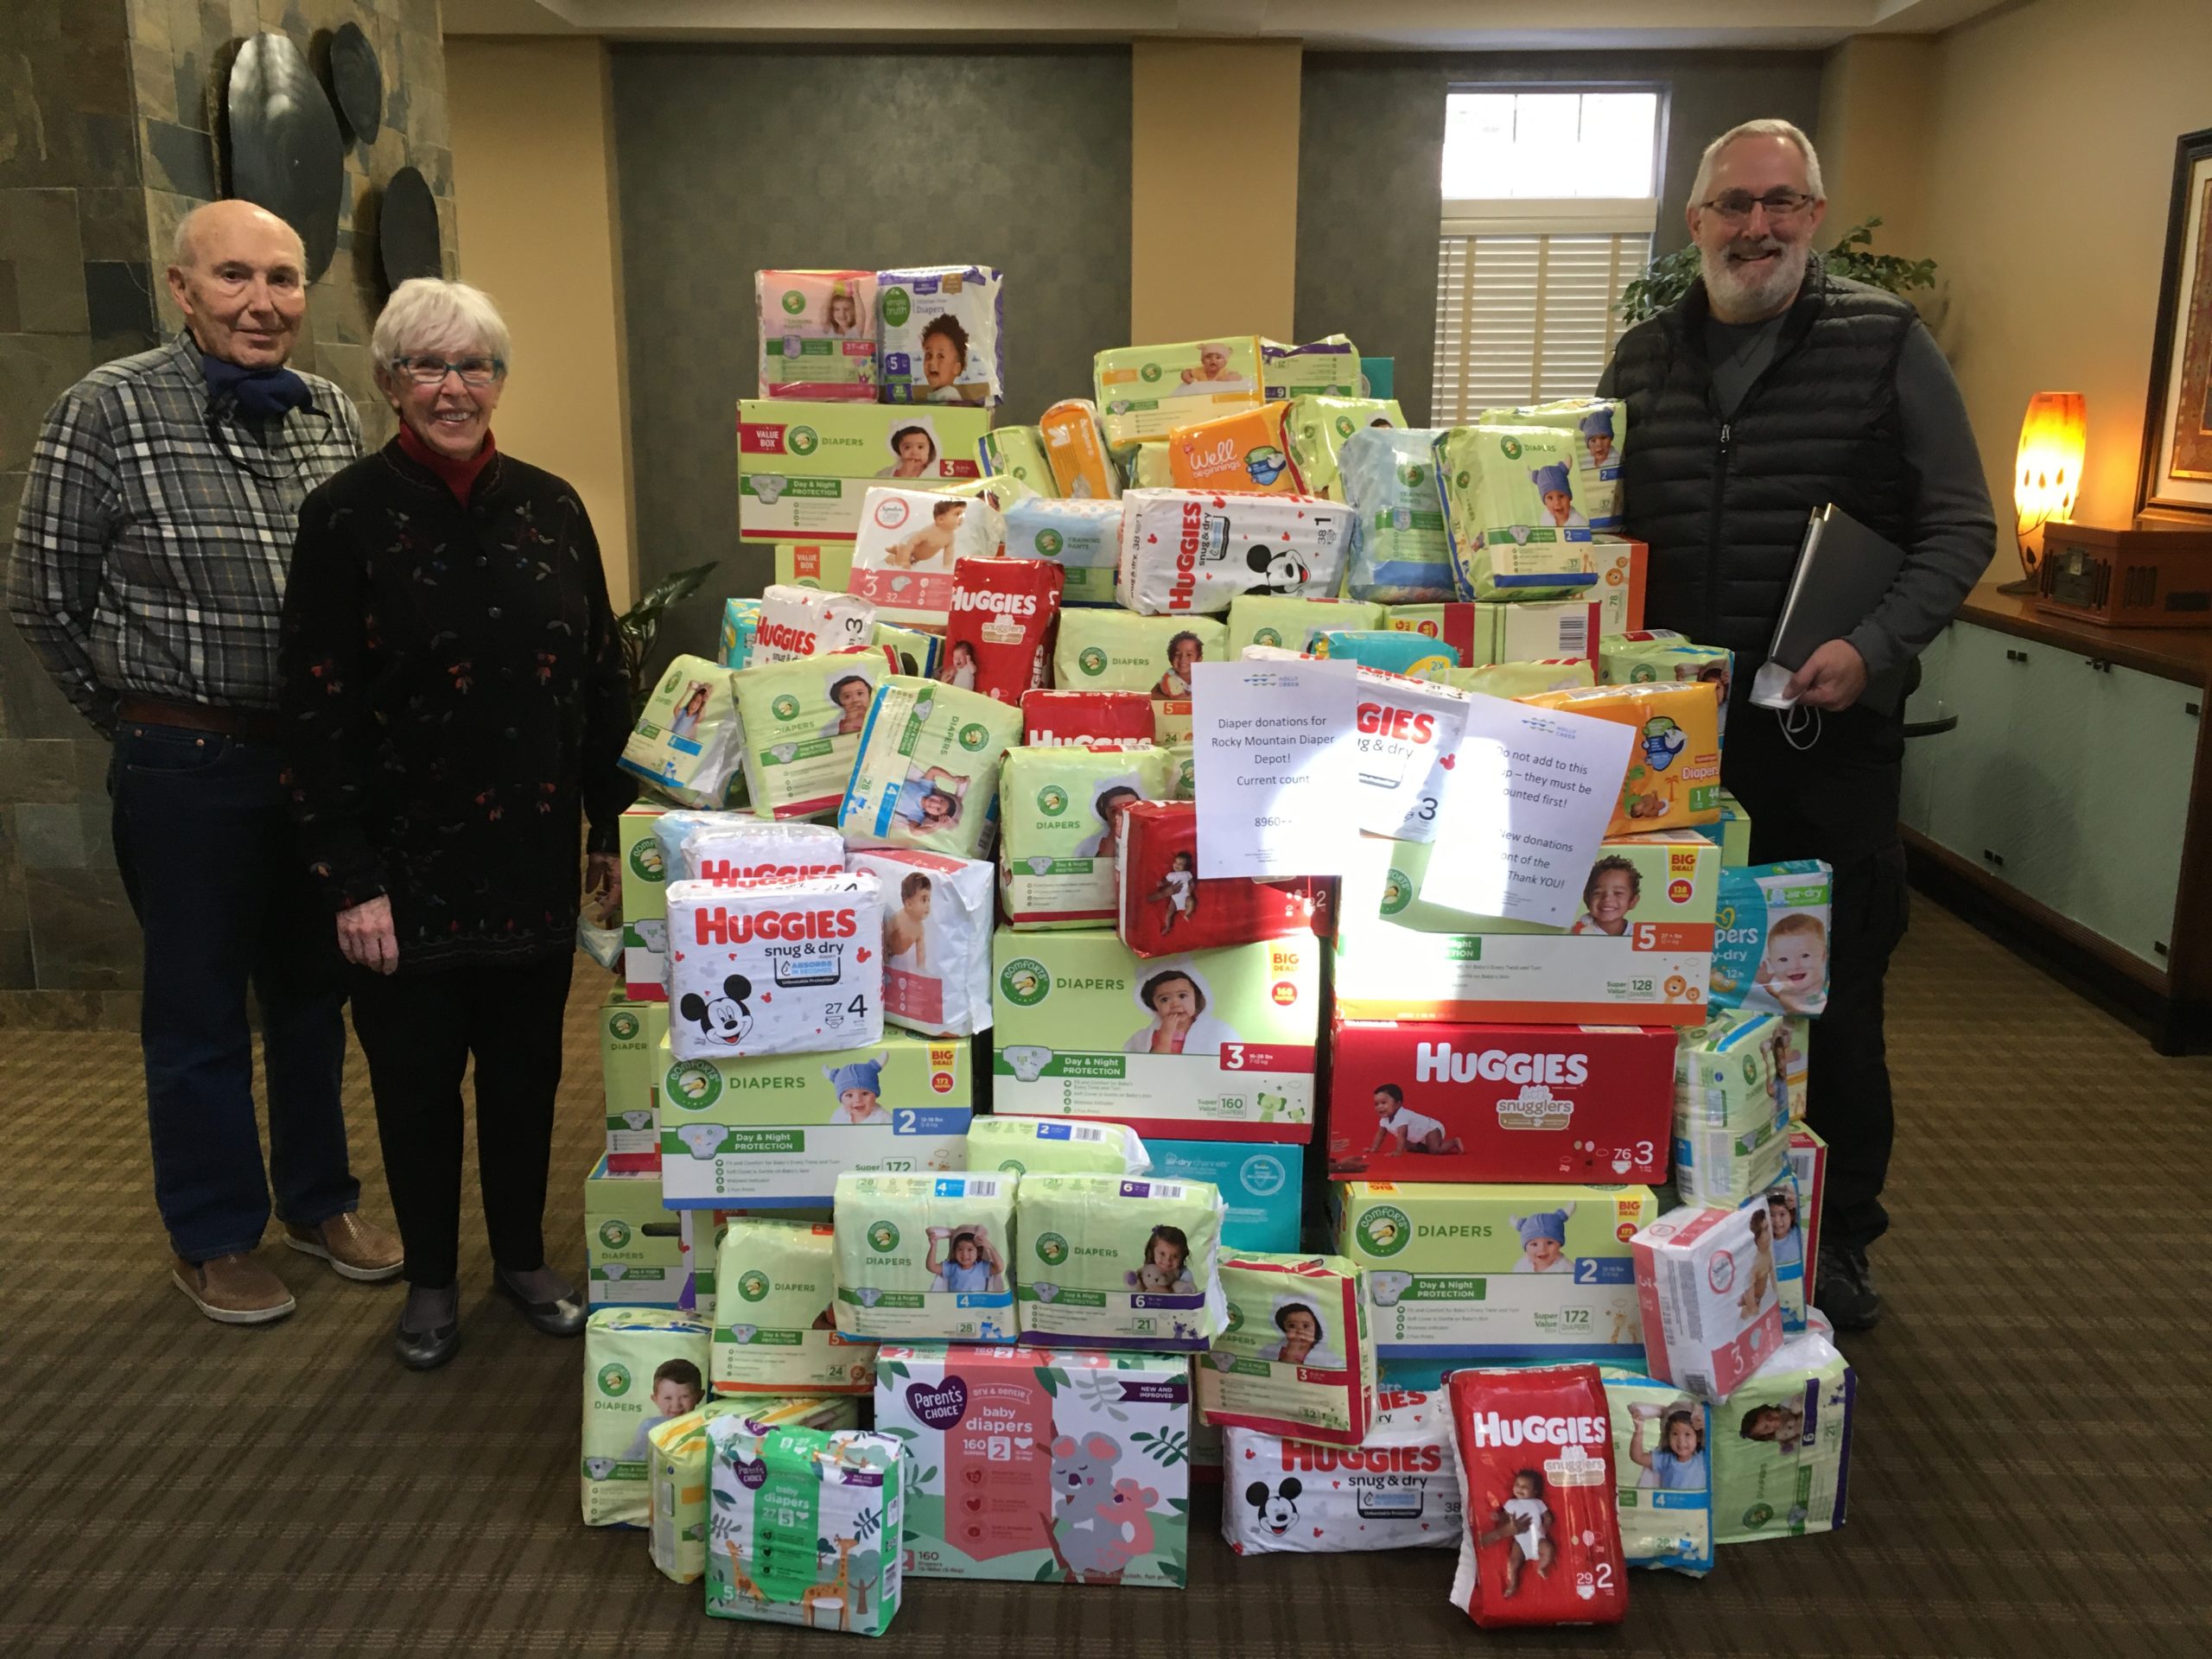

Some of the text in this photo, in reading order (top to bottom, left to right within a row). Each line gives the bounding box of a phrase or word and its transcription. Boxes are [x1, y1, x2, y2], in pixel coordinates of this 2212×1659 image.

[887, 305, 907, 315] truth
[917, 306, 944, 315] Diapers
[890, 357, 898, 370] 5
[756, 430, 779, 439] VALUE
[822, 437, 863, 446] DIAPERS
[1190, 439, 1237, 471] Well
[1524, 443, 1556, 454] DIAPERS
[944, 461, 954, 475] 3
[1193, 460, 1240, 480] beginnings
[1600, 470, 1607, 480] 2
[1317, 530, 1326, 544] 38
[1566, 529, 1573, 541] 2
[796, 553, 817, 563] VALUE
[1169, 502, 1201, 609] HUGGIES
[862, 573, 879, 597] 3
[886, 593, 897, 603] 32
[951, 586, 1037, 615] HUGGIES
[846, 618, 862, 632] 3
[983, 623, 1025, 636] snugglers
[755, 616, 816, 655] HUGGIES
[1431, 660, 1444, 671] 2X
[1166, 703, 1173, 714] 5
[775, 721, 815, 734] DIAPERS
[1218, 716, 1327, 730] Diaper donations for
[1357, 702, 1434, 745] GIES
[940, 716, 959, 755] DIAPERS
[1166, 734, 1177, 742] 24
[1211, 734, 1335, 748] Rocky Mountain Diaper
[1373, 739, 1414, 759] & dry
[1255, 753, 1291, 766] Depot!
[1512, 752, 1530, 762] not
[1533, 755, 1552, 768] add
[1555, 760, 1566, 771] to
[1569, 762, 1588, 775] this
[1237, 775, 1309, 785] Current count
[1682, 766, 1719, 781] Diapers
[861, 779, 872, 790] 28
[886, 785, 896, 794] 4
[1524, 772, 1548, 786] they
[1550, 778, 1575, 791] must
[1578, 784, 1592, 795] be
[1503, 788, 1567, 809] ounted first!
[1419, 797, 1438, 821] 3
[1037, 821, 1080, 830] DIAPERS
[1523, 834, 1573, 852] donations
[1501, 853, 1550, 868] ont of the
[1671, 854, 1695, 865] BIG
[1508, 870, 1565, 889] Thank YOU!
[1673, 885, 1688, 894] 128
[695, 906, 857, 946] HUGGIES
[1637, 925, 1656, 950] 5
[1715, 928, 1758, 949] pers
[765, 942, 844, 959] snug & dry
[1273, 953, 1300, 964] BIG
[1003, 959, 1048, 980] COMFORTS
[1057, 978, 1125, 990] DIAPERS
[1606, 981, 1627, 990] Super
[1631, 979, 1652, 991] 128
[1274, 987, 1294, 996] 160
[825, 994, 868, 1018] 27 4
[931, 1051, 954, 1060] BIG
[1227, 1045, 1244, 1070] 3
[1065, 1058, 1082, 1068] Day
[1093, 1058, 1118, 1069] Night
[1416, 1042, 1588, 1085] HUGGIES
[671, 1061, 719, 1081] COMFORTS
[1063, 1067, 1121, 1076] PROTECTION
[729, 1077, 805, 1090] DIAPERS
[1197, 1098, 1217, 1108] Super
[1221, 1098, 1243, 1109] 160
[1498, 1100, 1573, 1116] snugglers
[899, 1110, 917, 1133] 2
[1040, 1125, 1049, 1134] 2
[736, 1134, 753, 1143] Day
[766, 1133, 791, 1142] Night
[1613, 1141, 1653, 1165] 76 3
[1618, 1201, 1640, 1211] BIG
[1360, 1209, 1406, 1229] COMFORTS
[1417, 1225, 1492, 1237] DIAPERS
[1074, 1248, 1118, 1257] DIAPERS
[866, 1257, 912, 1267] DIAPERS
[1580, 1260, 1597, 1282] 2
[775, 1283, 815, 1293] DIAPERS
[1420, 1281, 1436, 1290] Day
[1447, 1281, 1472, 1290] Night
[960, 1296, 969, 1306] 4
[1135, 1296, 1145, 1306] 6
[1534, 1312, 1558, 1321] Super
[1564, 1310, 1588, 1323] 172
[960, 1324, 973, 1332] 28
[1137, 1319, 1151, 1329] 21
[830, 1333, 839, 1345] 5
[1731, 1344, 1744, 1374] 3
[829, 1367, 842, 1376] 24
[1300, 1369, 1307, 1381] 3
[914, 1385, 963, 1408] Parent's
[594, 1402, 642, 1413] DIAPERS
[925, 1406, 958, 1420] CHOICE
[983, 1407, 1015, 1420] baby
[966, 1420, 1033, 1433] diapers
[1473, 1412, 1605, 1447] HUGGIES
[963, 1439, 1005, 1459] 160 2
[1281, 1439, 1441, 1473] HUGGIES
[738, 1465, 765, 1476] Parent's
[1545, 1459, 1605, 1473] snugglers
[743, 1474, 763, 1483] CHOICE
[1348, 1475, 1427, 1491] snug & dry
[776, 1486, 798, 1497] baby
[764, 1494, 810, 1510] diapers
[1656, 1495, 1666, 1505] 4
[1444, 1502, 1461, 1512] 38
[918, 1552, 939, 1560] 160
[1576, 1563, 1613, 1588] 29 2
[723, 1586, 734, 1599] 5
